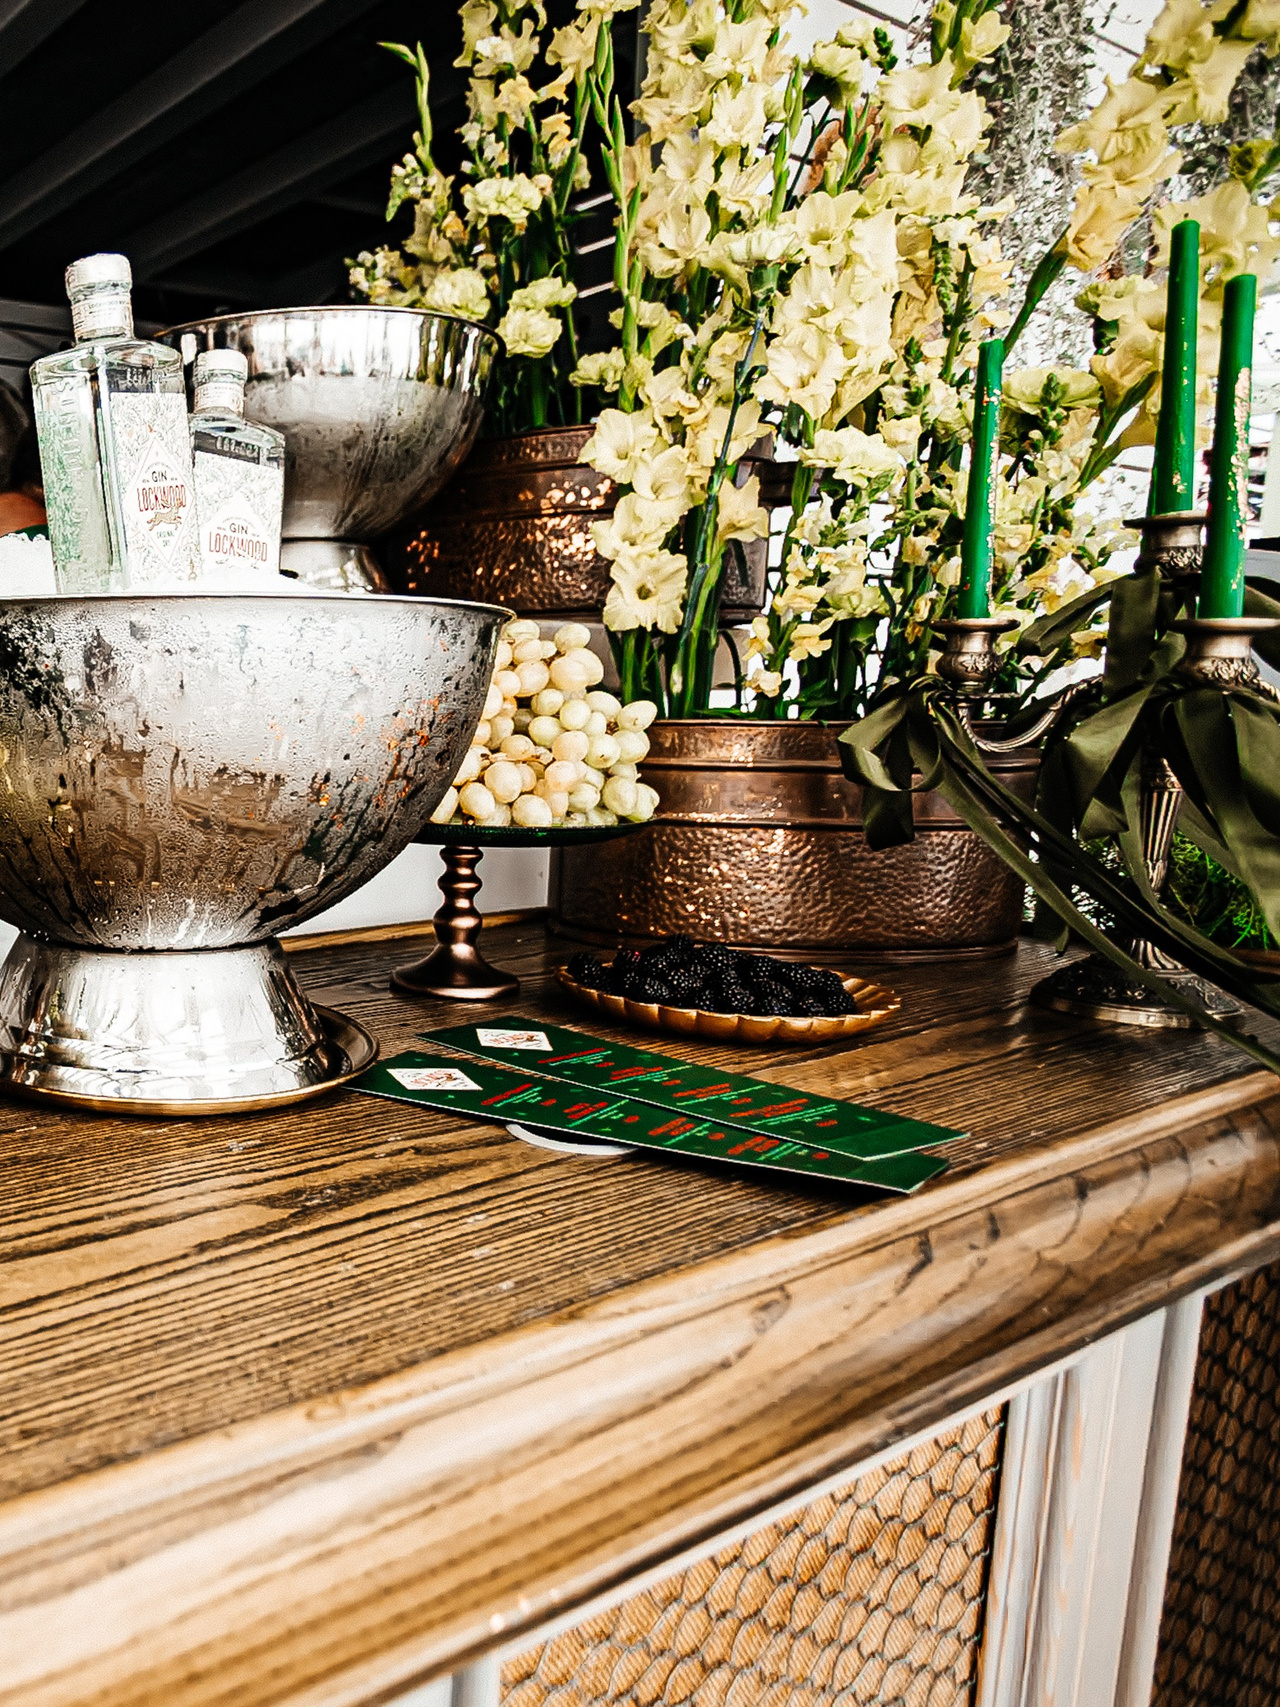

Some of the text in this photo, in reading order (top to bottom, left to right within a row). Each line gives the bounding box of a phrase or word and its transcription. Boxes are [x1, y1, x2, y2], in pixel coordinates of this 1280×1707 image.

[151, 470, 168, 482] GIN
[136, 484, 186, 512] LOCKWOOD
[229, 522, 249, 535] GIN
[208, 531, 268, 562] LOCKWOOD
